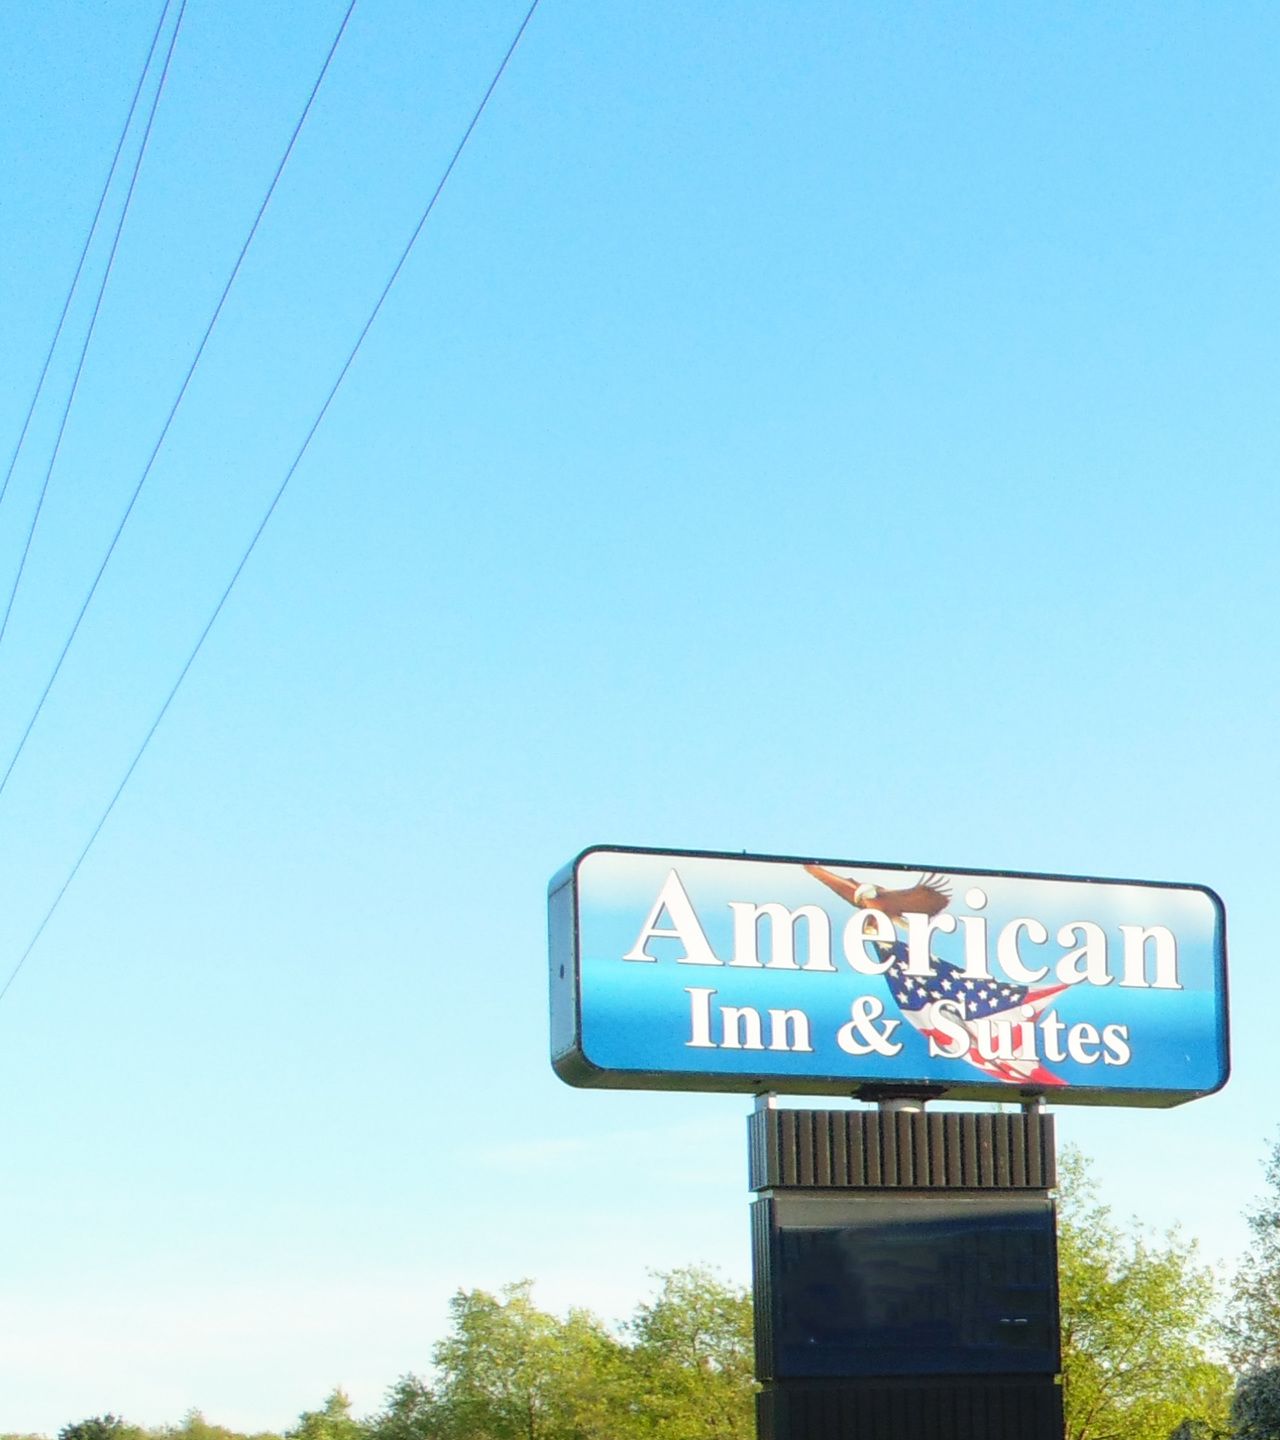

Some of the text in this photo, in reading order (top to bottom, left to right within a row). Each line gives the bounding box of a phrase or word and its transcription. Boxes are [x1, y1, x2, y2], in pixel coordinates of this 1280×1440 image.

[622, 867, 1183, 990] American
[684, 986, 1131, 1066] Inn & Suites
